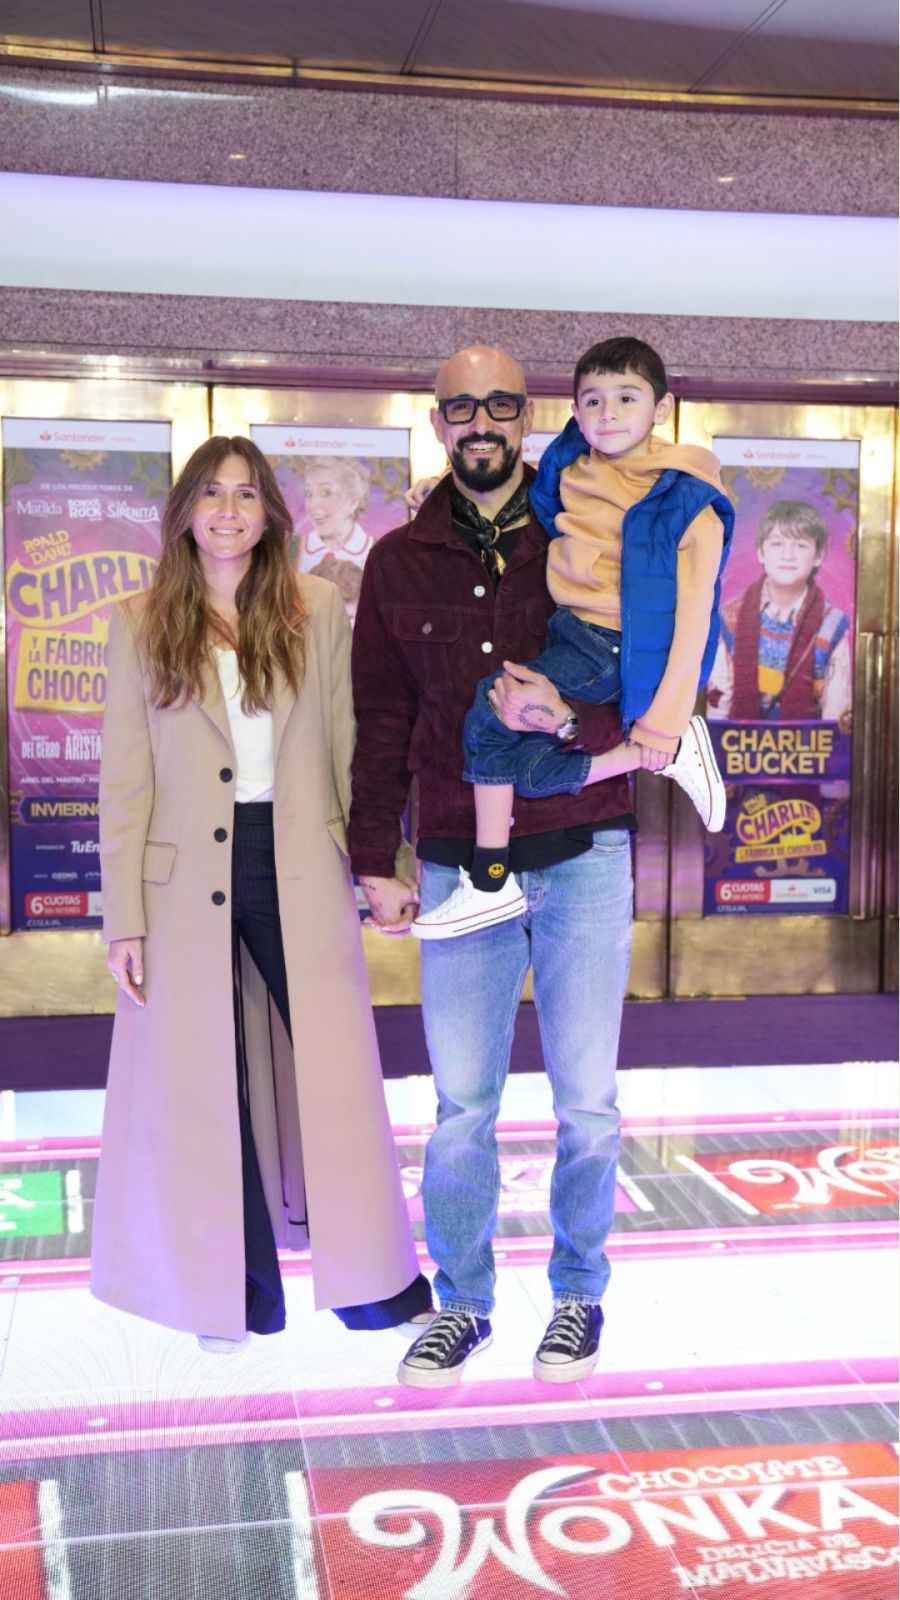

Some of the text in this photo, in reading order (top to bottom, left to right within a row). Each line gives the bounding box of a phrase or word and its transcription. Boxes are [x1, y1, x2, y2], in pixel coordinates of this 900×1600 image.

[54, 432, 106, 443] Santander
[298, 438, 347, 449] Santander
[17, 500, 62, 515] Matilda
[69, 506, 102, 518] ROCK
[24, 530, 69, 552] ROALD
[32, 636, 39, 649] Y
[28, 650, 41, 663] LA
[27, 667, 107, 704] CHOCO
[721, 729, 834, 752] CHARLIE
[726, 753, 830, 774] BUCKET
[740, 803, 816, 840] CHARLIE
[720, 883, 765, 901] 6 CUOTAS
[812, 886, 832, 894] VISA
[30, 895, 81, 915] 6 CUOTAS
[598, 1456, 849, 1498] CHOCOLATE
[348, 1465, 899, 1600] WONKA
[696, 1532, 862, 1562] DELICIA DE
